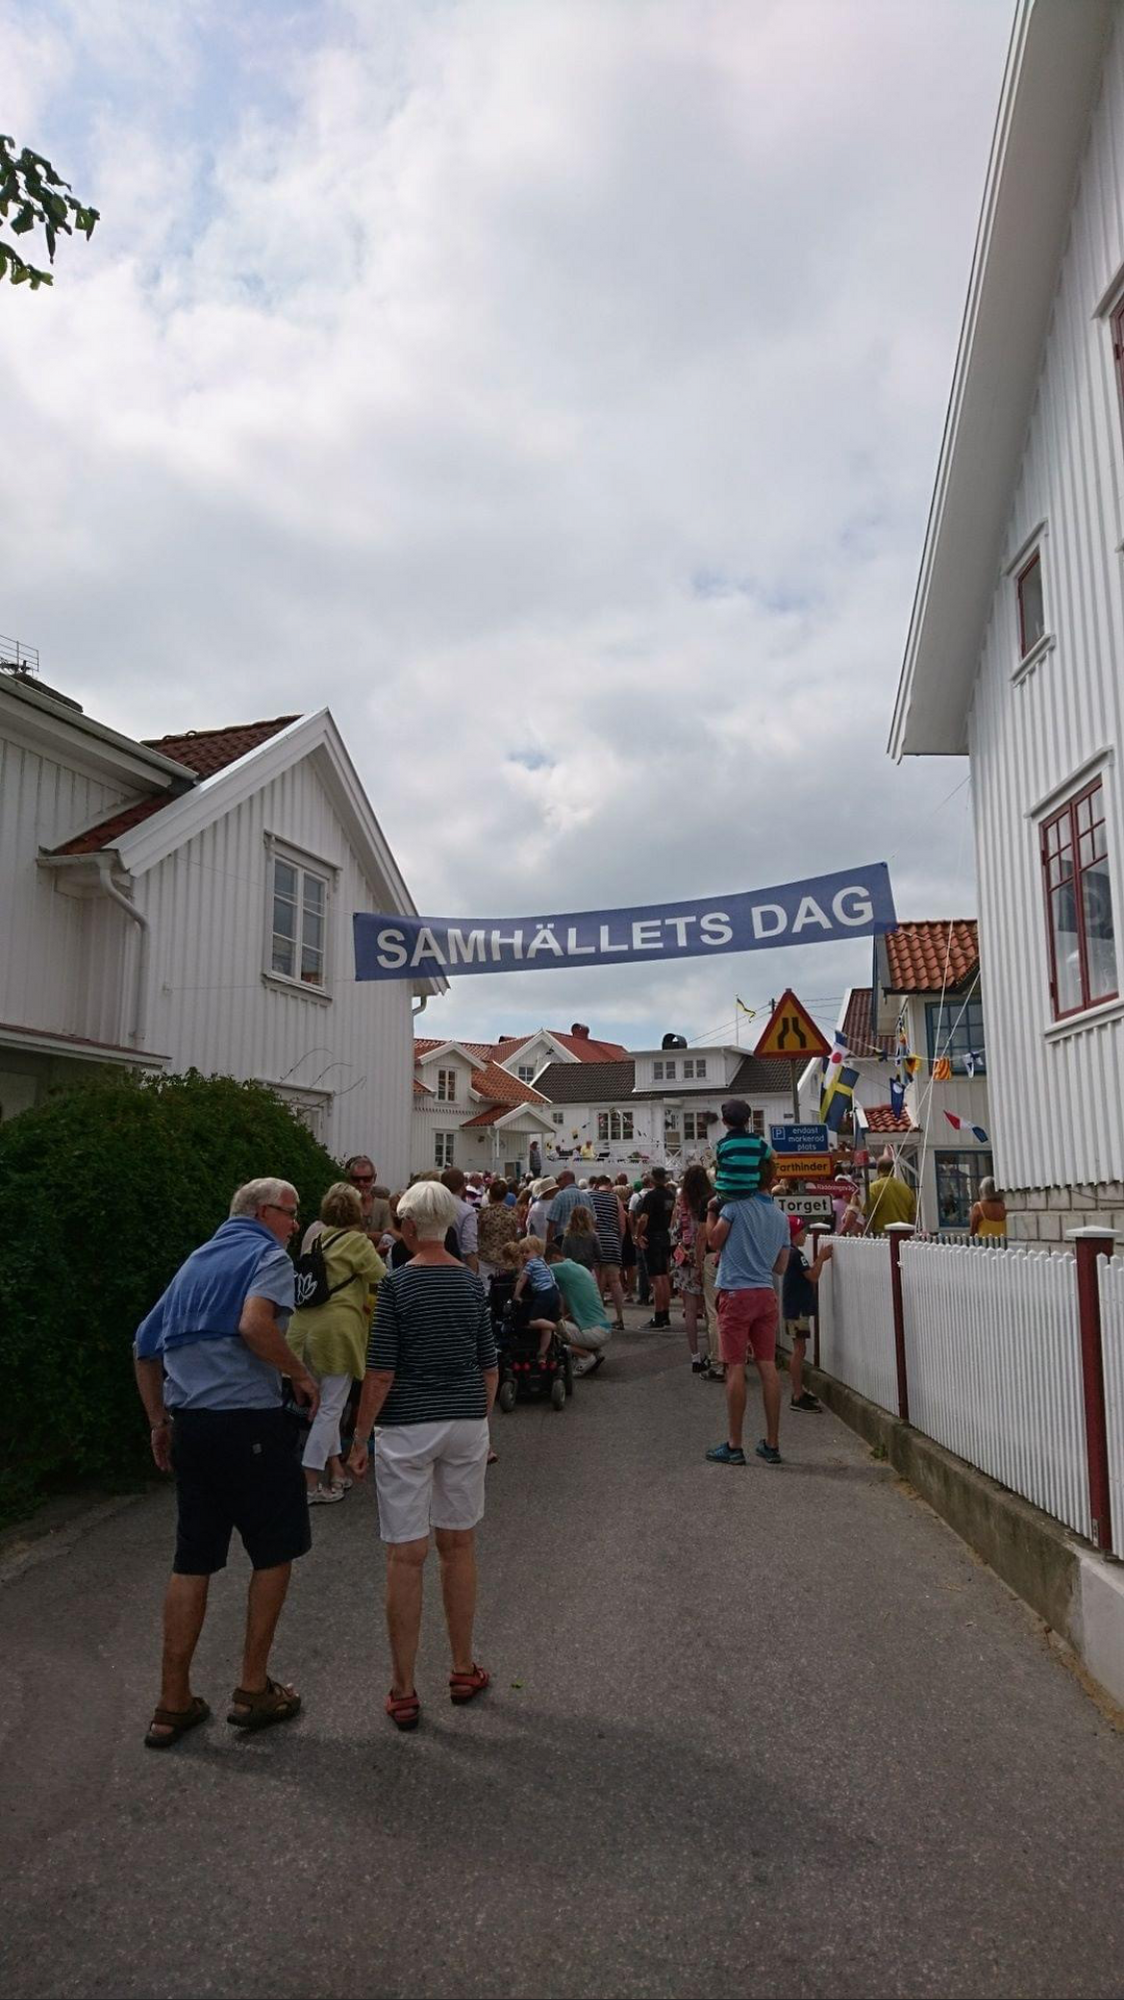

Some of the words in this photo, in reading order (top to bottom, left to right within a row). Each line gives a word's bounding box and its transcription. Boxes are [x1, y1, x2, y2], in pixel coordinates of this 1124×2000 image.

[376, 911, 733, 969] SAMHÄLLETS
[751, 885, 874, 939] DAG
[792, 1127, 818, 1135] endast
[788, 1135, 824, 1143] markerad
[797, 1143, 817, 1151] plats
[778, 1199, 827, 1214] Torget
